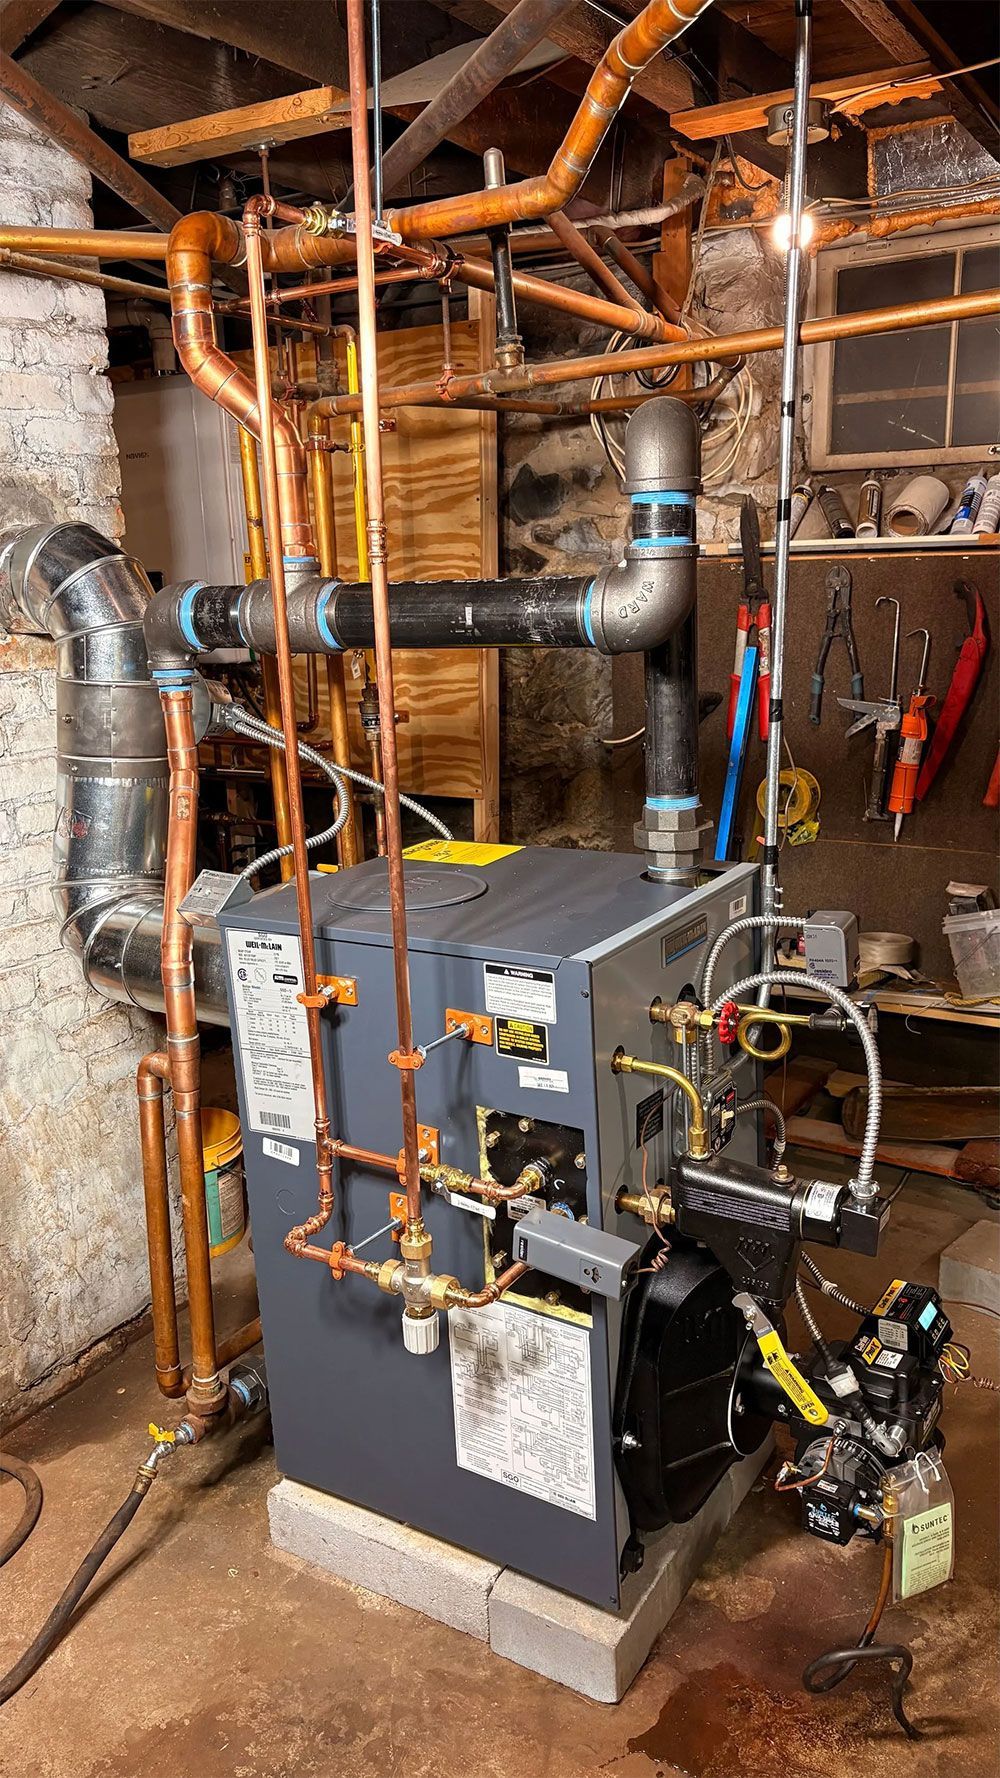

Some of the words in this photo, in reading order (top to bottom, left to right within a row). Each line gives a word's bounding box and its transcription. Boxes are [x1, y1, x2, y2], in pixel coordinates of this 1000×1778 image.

[618, 581, 655, 619] WARD
[510, 969, 534, 979] WARNING
[513, 1022, 533, 1031] CAUTION
[800, 1401, 815, 1411] OPEN
[502, 1471, 520, 1483] SGO
[920, 1514, 948, 1532] SUNTEC
